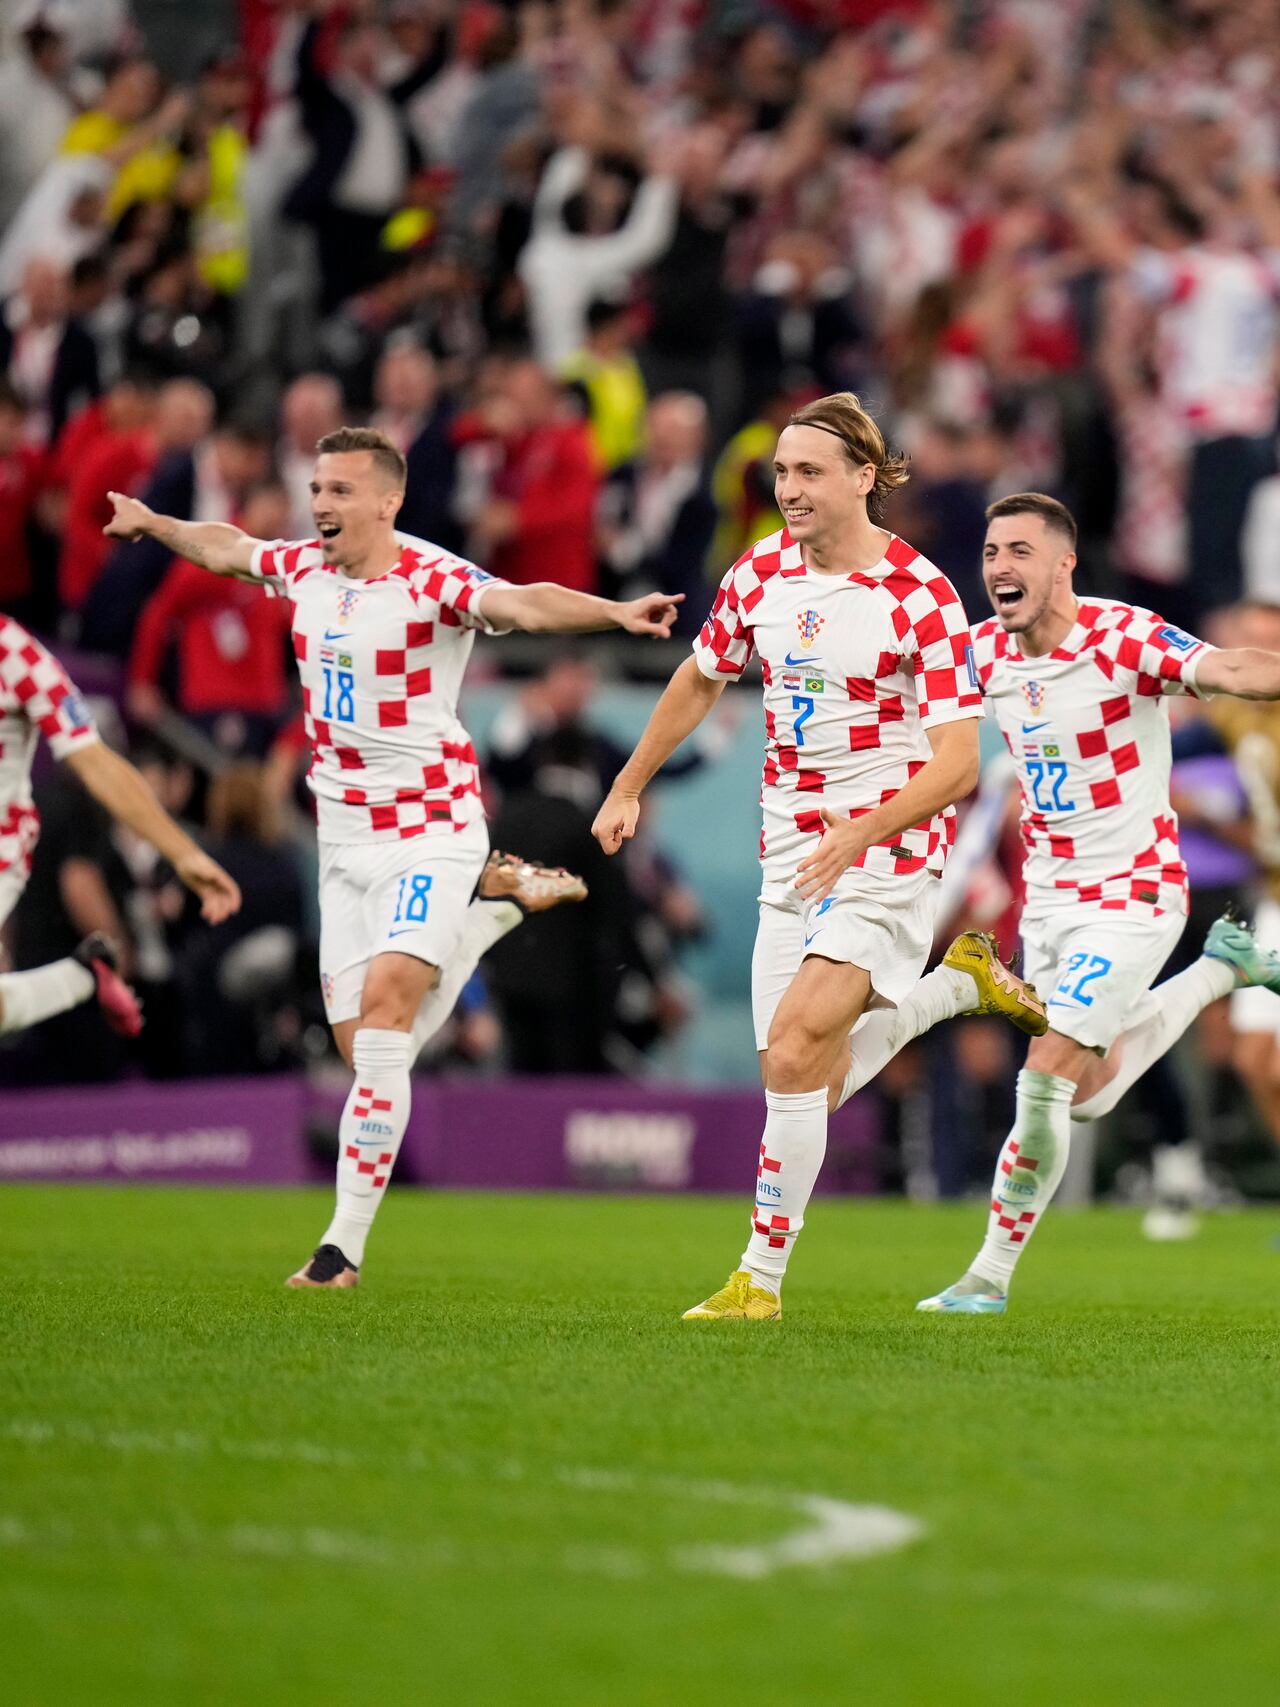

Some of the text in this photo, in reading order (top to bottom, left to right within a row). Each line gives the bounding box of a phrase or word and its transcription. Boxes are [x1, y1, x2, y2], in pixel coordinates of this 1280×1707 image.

[322, 667, 355, 723] 18
[791, 695, 815, 747] 7
[1024, 760, 1076, 813] 22
[393, 873, 434, 923] 18
[1056, 951, 1113, 1007] 22
